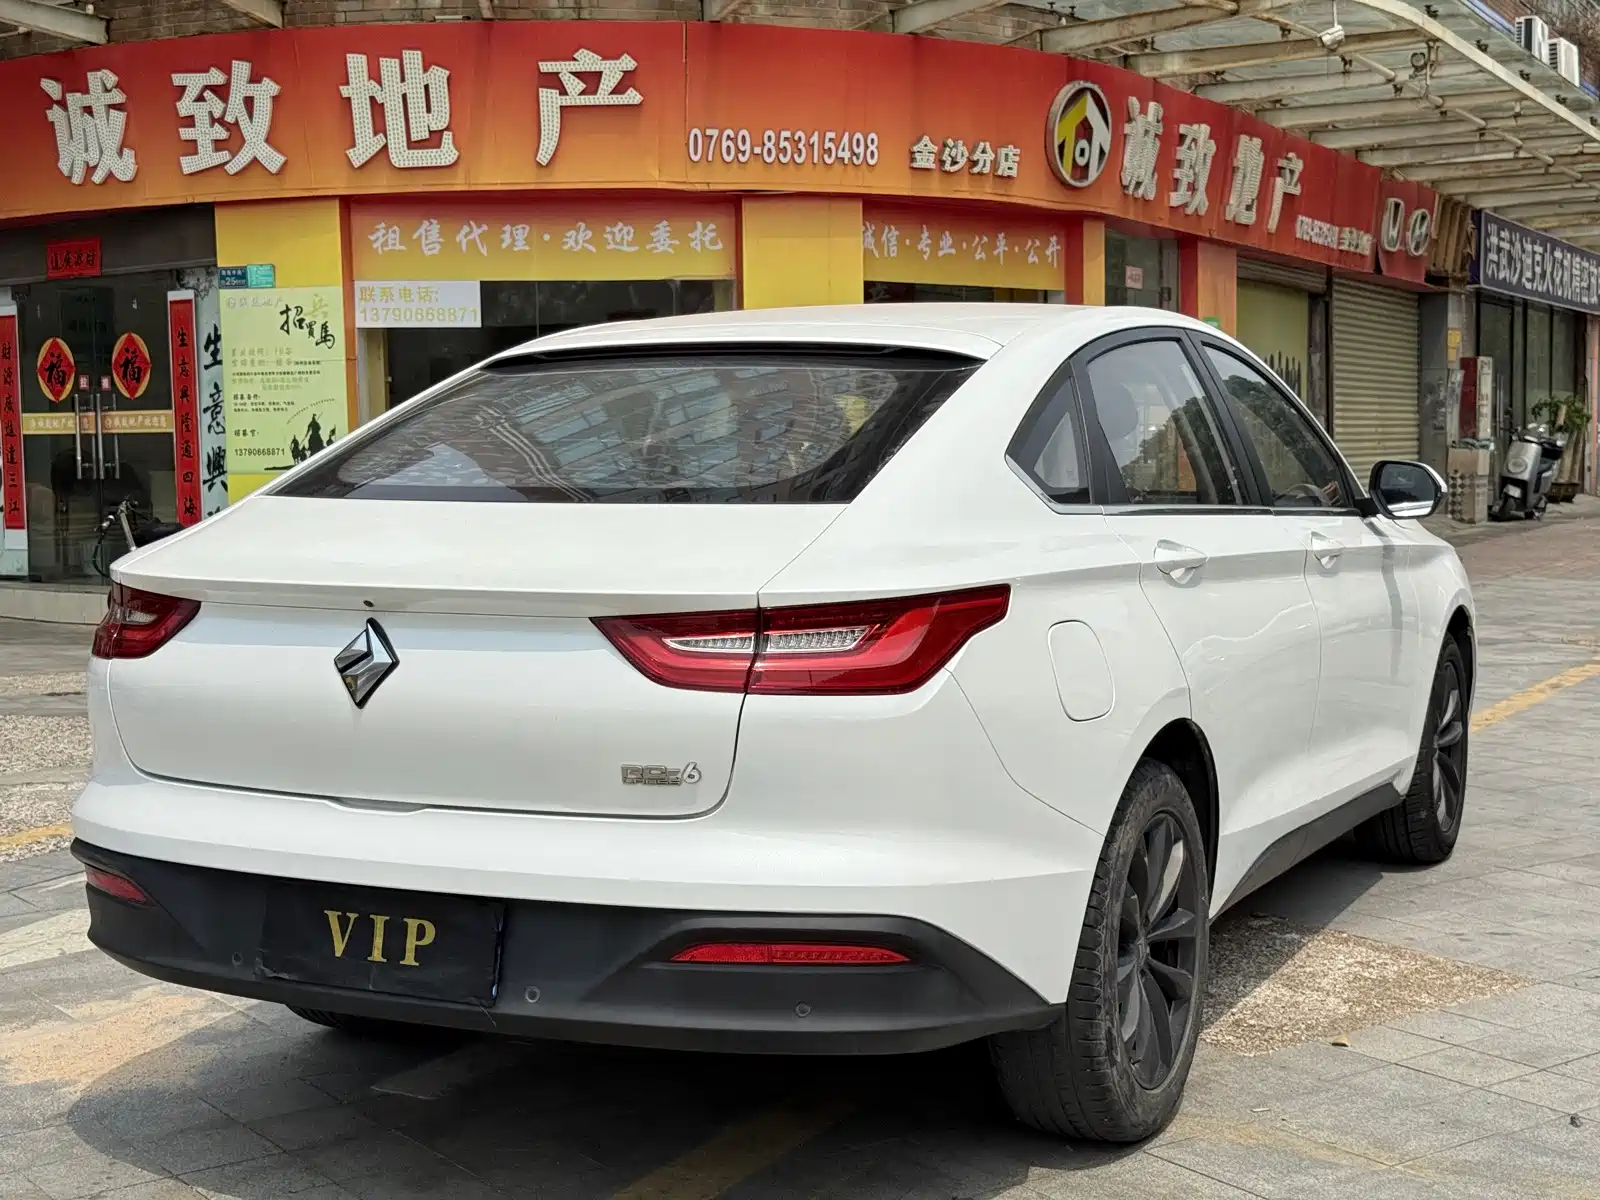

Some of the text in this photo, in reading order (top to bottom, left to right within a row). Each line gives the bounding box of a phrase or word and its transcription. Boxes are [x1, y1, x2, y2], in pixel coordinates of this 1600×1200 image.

[41, 49, 643, 185] 诚致地产
[687, 128, 880, 168] 0769-85315498
[910, 135, 1021, 178] 金沙分店
[1121, 96, 1303, 234] 诚致地产
[359, 306, 479, 323] 13790668871
[44, 351, 67, 388] 福
[120, 346, 143, 384] 福
[203, 323, 228, 518] 生意興
[234, 447, 285, 457] 13790668871
[323, 909, 437, 967] VIP
